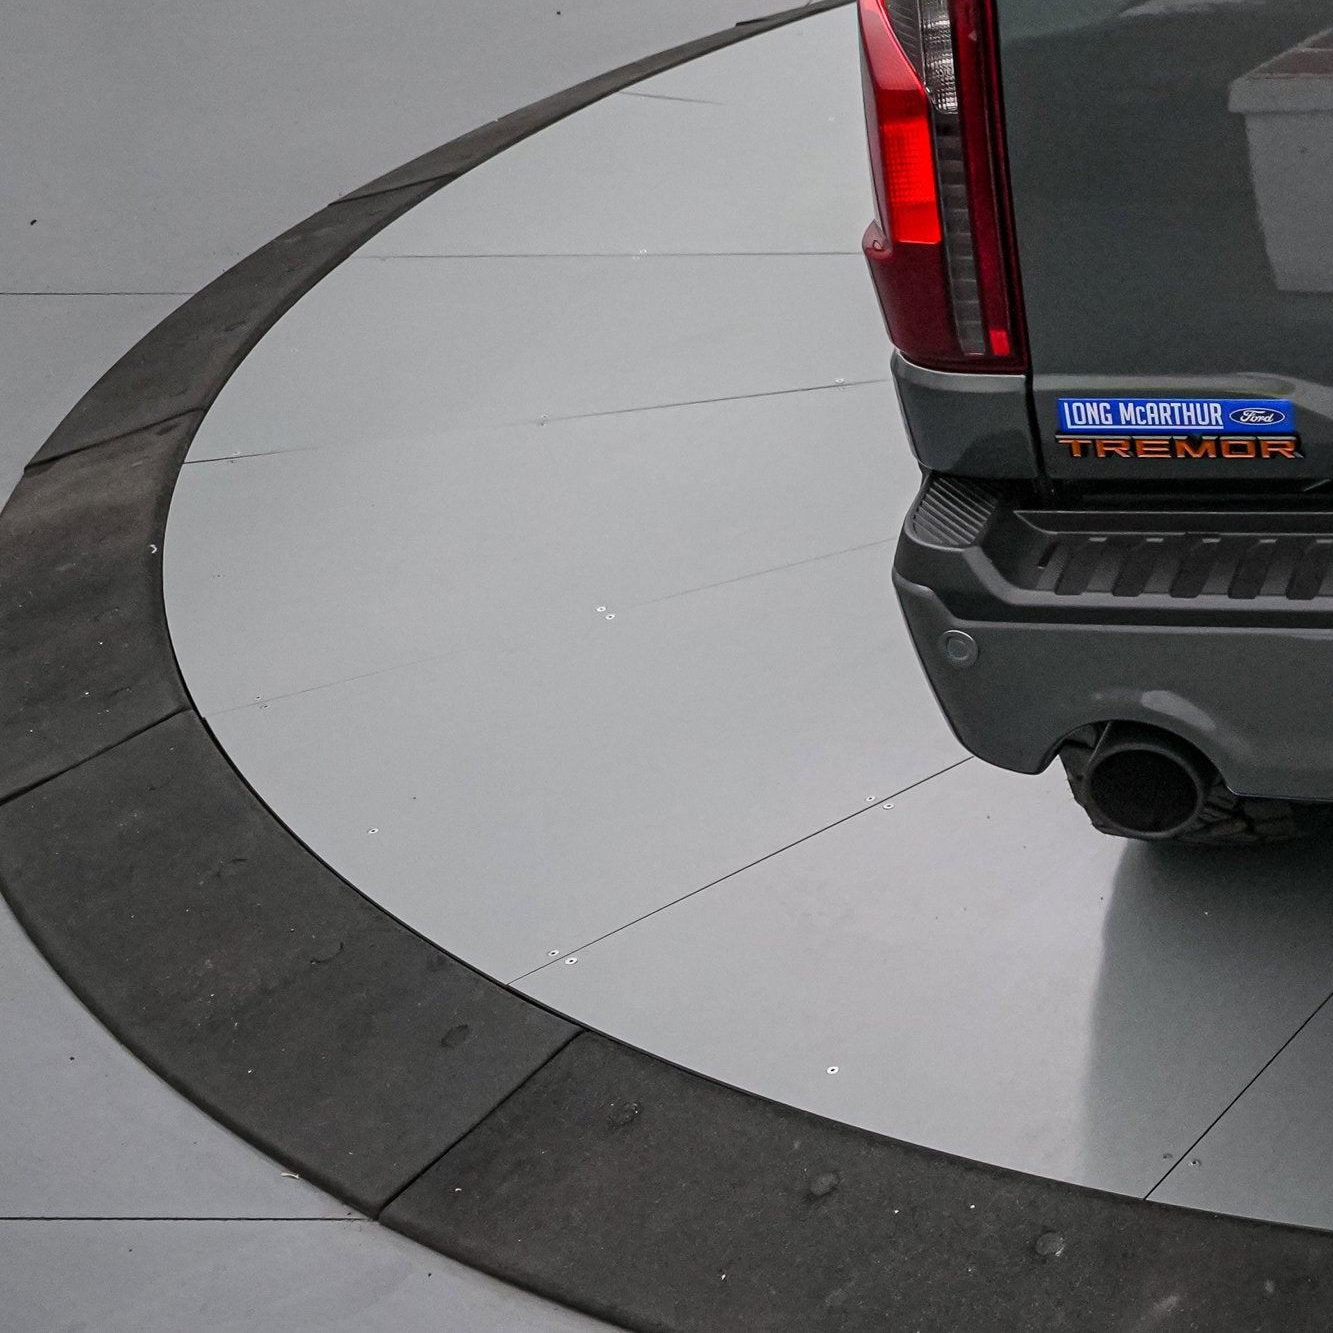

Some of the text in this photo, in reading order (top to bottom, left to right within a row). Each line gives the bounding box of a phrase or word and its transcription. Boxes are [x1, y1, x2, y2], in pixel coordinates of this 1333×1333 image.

[1063, 402, 1112, 429] LONG
[1120, 403, 1223, 426] McARTHUR
[1055, 434, 1304, 459] TREMOR
